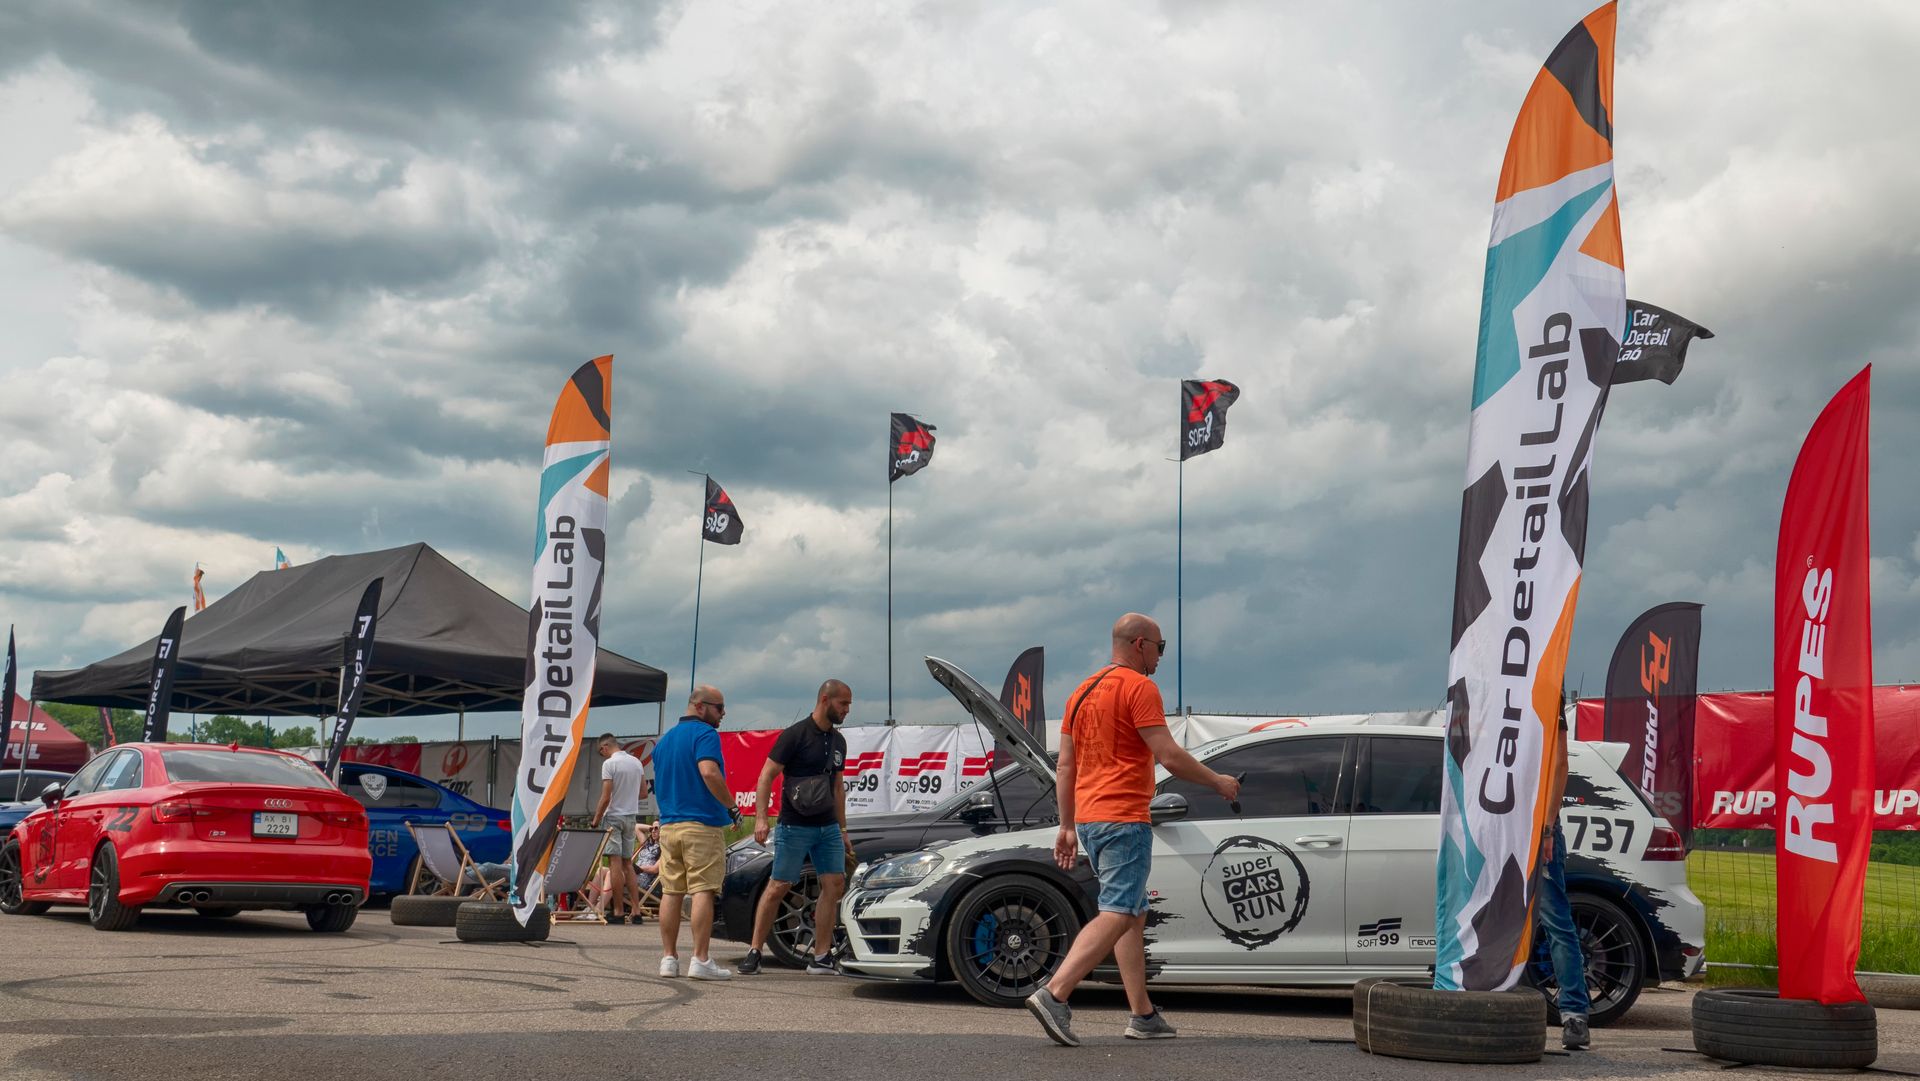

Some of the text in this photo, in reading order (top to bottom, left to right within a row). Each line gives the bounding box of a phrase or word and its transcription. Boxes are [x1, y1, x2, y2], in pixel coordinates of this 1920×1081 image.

[1633, 309, 1660, 327] Car
[1624, 328, 1671, 346] Detail
[1617, 347, 1642, 362] Lab
[1785, 567, 1838, 863] RUPES
[1478, 688, 1522, 815] Car
[895, 775, 942, 794] SOFT99
[1711, 790, 1777, 815] RUP
[1873, 789, 1920, 816] UP
[107, 806, 140, 833] 22
[267, 824, 290, 834] 2229
[450, 812, 488, 832] 99
[1567, 815, 1635, 854] 737
[1222, 855, 1273, 878] super
[1227, 872, 1280, 899] CARS
[1232, 892, 1286, 924] RUN
[1357, 933, 1400, 948] SOFT99
